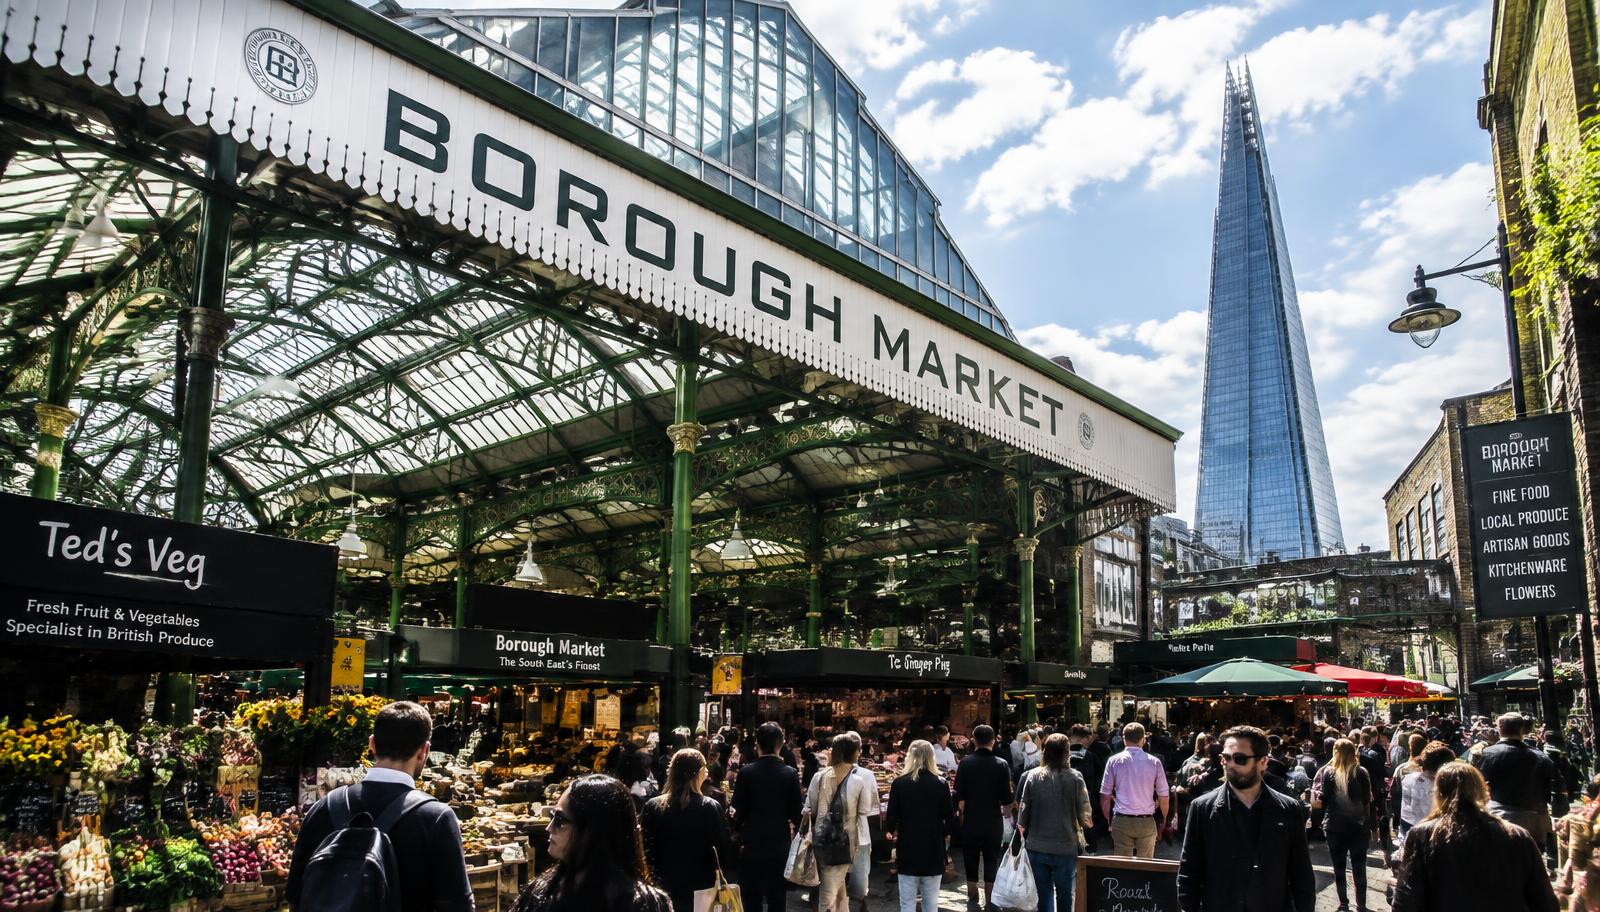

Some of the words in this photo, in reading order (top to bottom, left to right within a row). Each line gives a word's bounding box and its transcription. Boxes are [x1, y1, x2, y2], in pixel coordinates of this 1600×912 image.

[384, 88, 842, 343] BOROUGH
[873, 313, 1064, 436] MARKET
[1492, 454, 1541, 473] MARKET
[1492, 488, 1517, 504] FINE
[1521, 484, 1550, 501] FOOD
[1481, 515, 1514, 530] LOCAL
[1518, 507, 1569, 526] PRODUCE
[1483, 536, 1528, 554] ARTISAN
[1532, 532, 1570, 549] GOODS
[39, 521, 133, 568] Ted's
[148, 537, 206, 590] Veg
[1488, 558, 1568, 578] KITCHENWARE
[1505, 584, 1556, 600] FLOWERS
[27, 599, 69, 616] Fresh
[74, 603, 109, 620] Fruit
[114, 607, 125, 621] &
[129, 609, 200, 628] Vegetables
[6, 619, 83, 638] Specialist
[87, 625, 102, 640] in
[107, 626, 153, 644] British
[158, 631, 214, 648] Produce
[495, 634, 554, 657] Borough
[559, 639, 606, 657] Market
[499, 657, 516, 667] The
[518, 657, 544, 668] South
